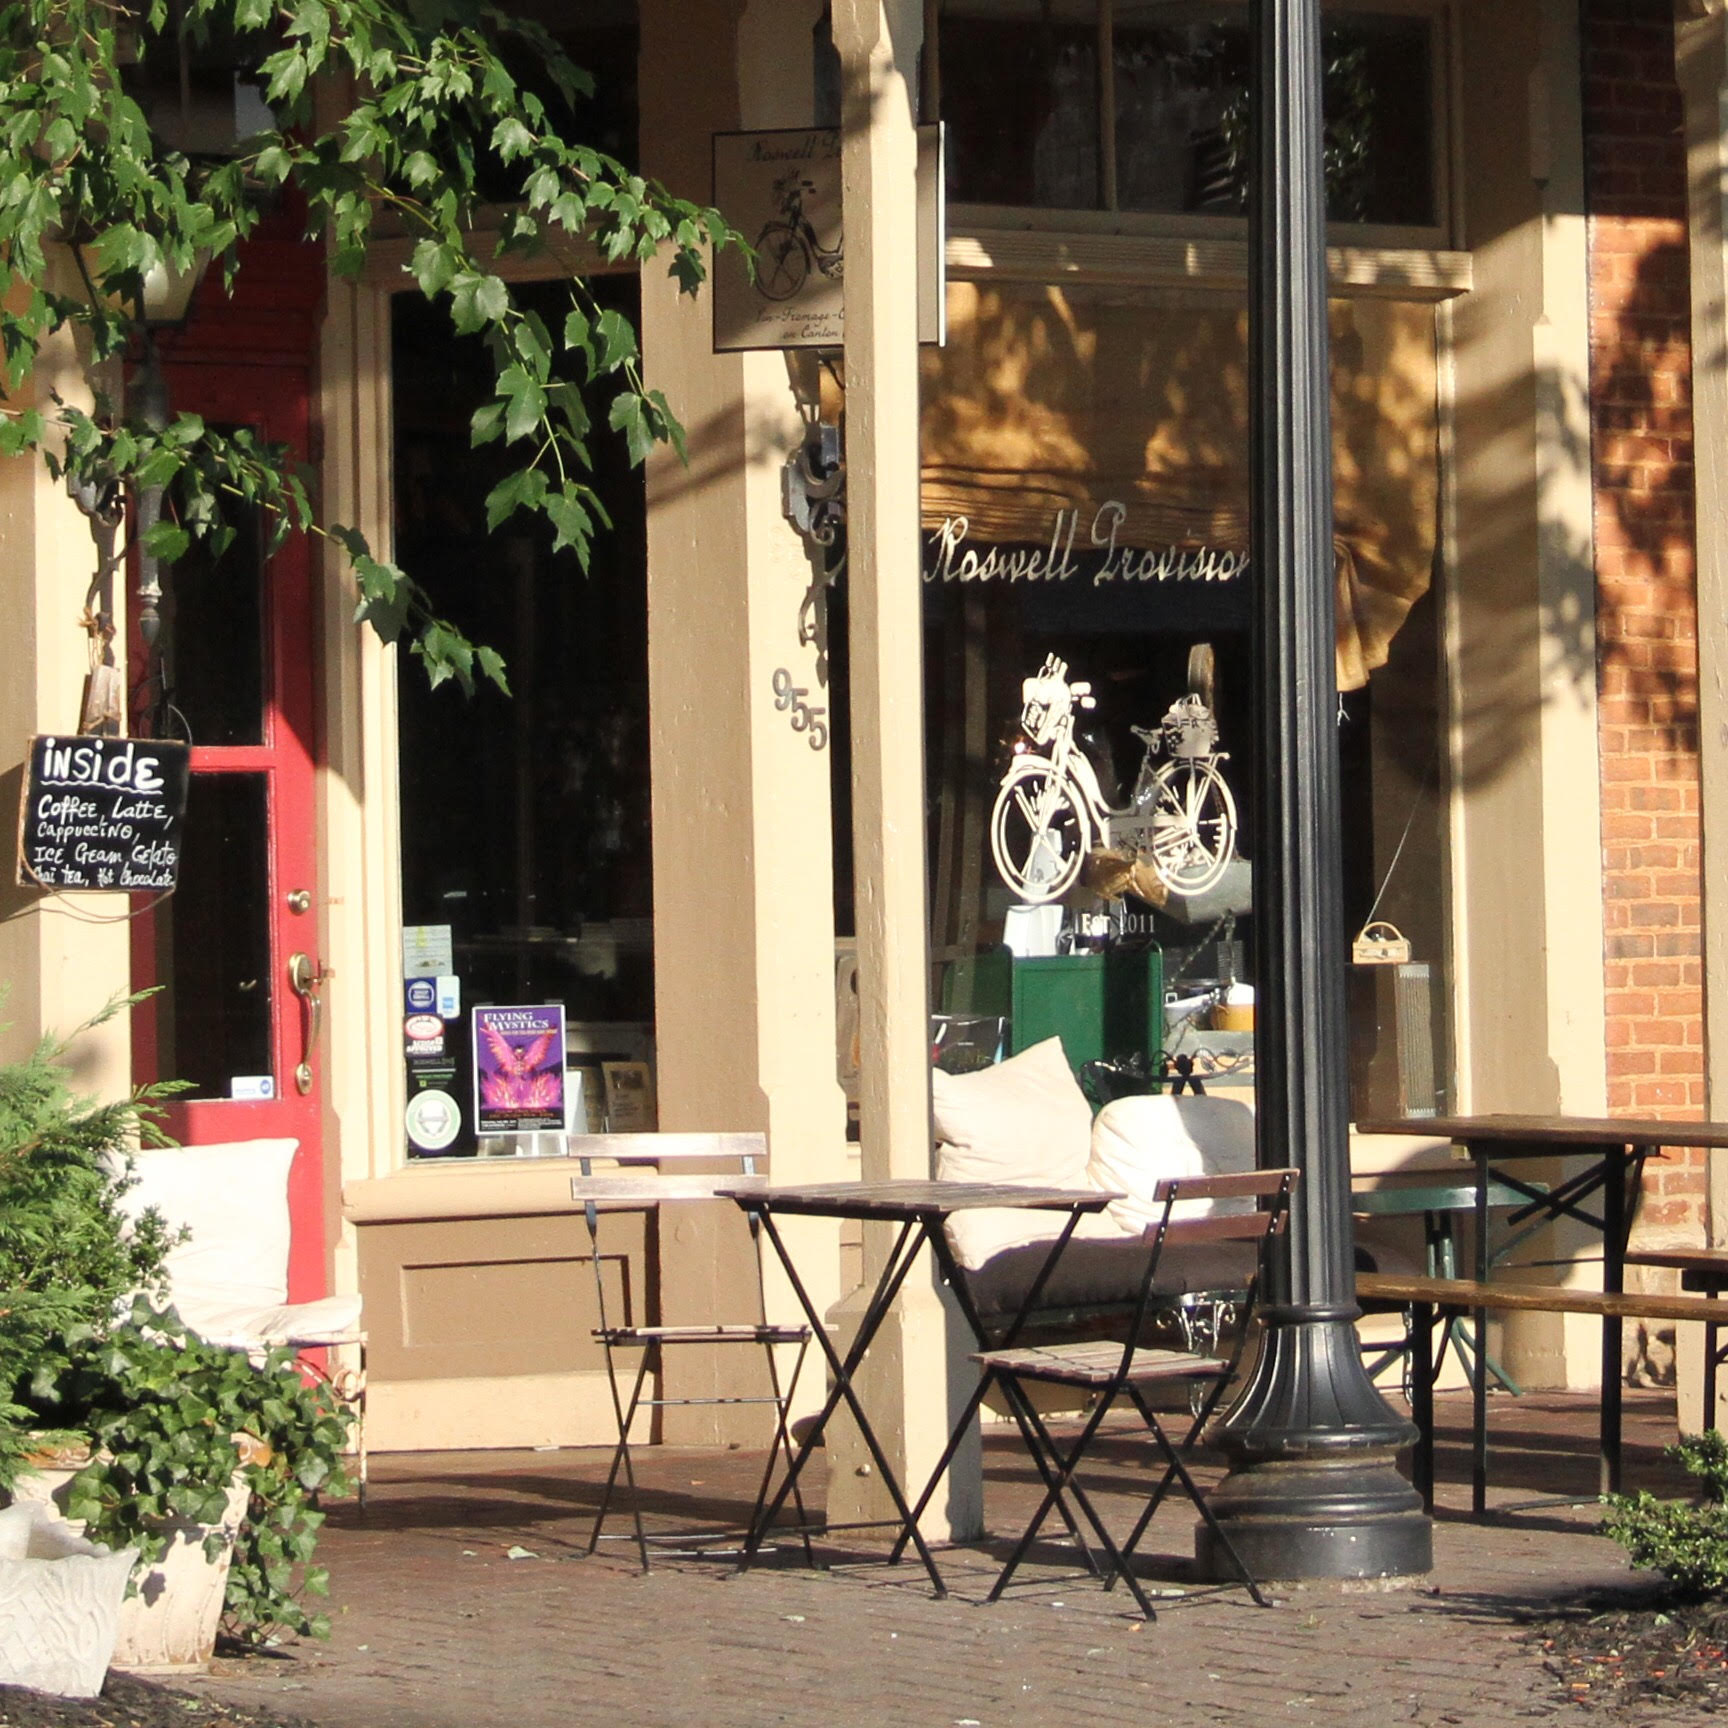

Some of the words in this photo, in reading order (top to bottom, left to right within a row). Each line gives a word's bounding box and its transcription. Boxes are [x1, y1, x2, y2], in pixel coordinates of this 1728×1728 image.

[922, 509, 1079, 584] Roswell
[772, 667, 828, 752] 955
[483, 1012, 533, 1023] FLYING
[489, 1019, 549, 1031] MYSTICS
